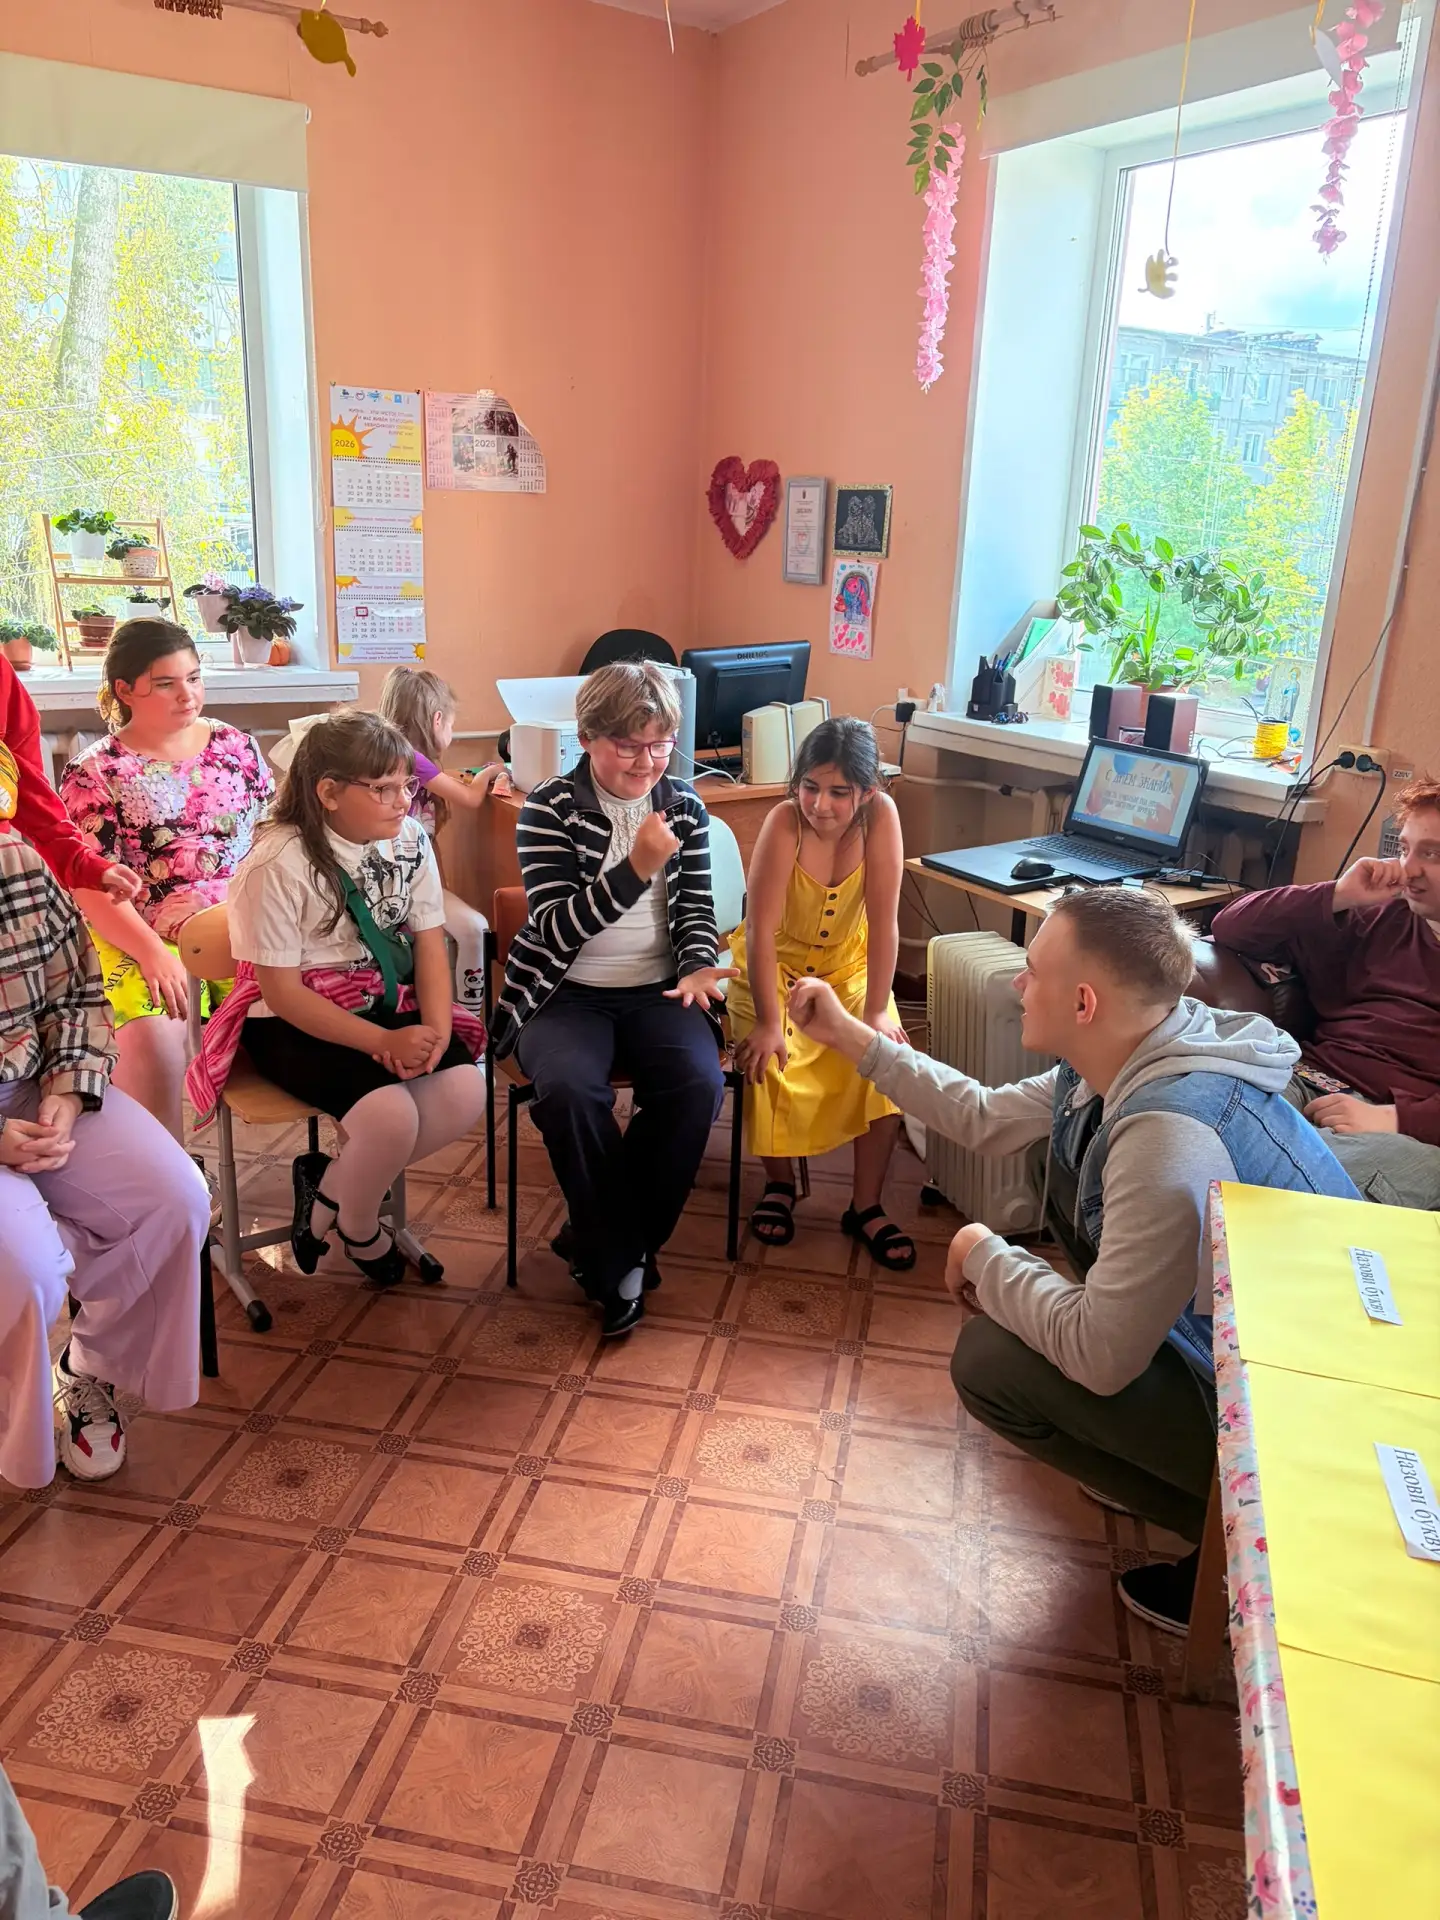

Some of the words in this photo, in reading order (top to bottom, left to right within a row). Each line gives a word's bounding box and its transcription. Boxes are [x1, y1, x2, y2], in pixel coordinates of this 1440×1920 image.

[335, 440, 355, 448] 2026
[737, 651, 768, 660] PHILIPS
[1355, 1248, 1375, 1285] Назови
[1361, 1287, 1386, 1316] букву
[1393, 1448, 1427, 1505] Назови
